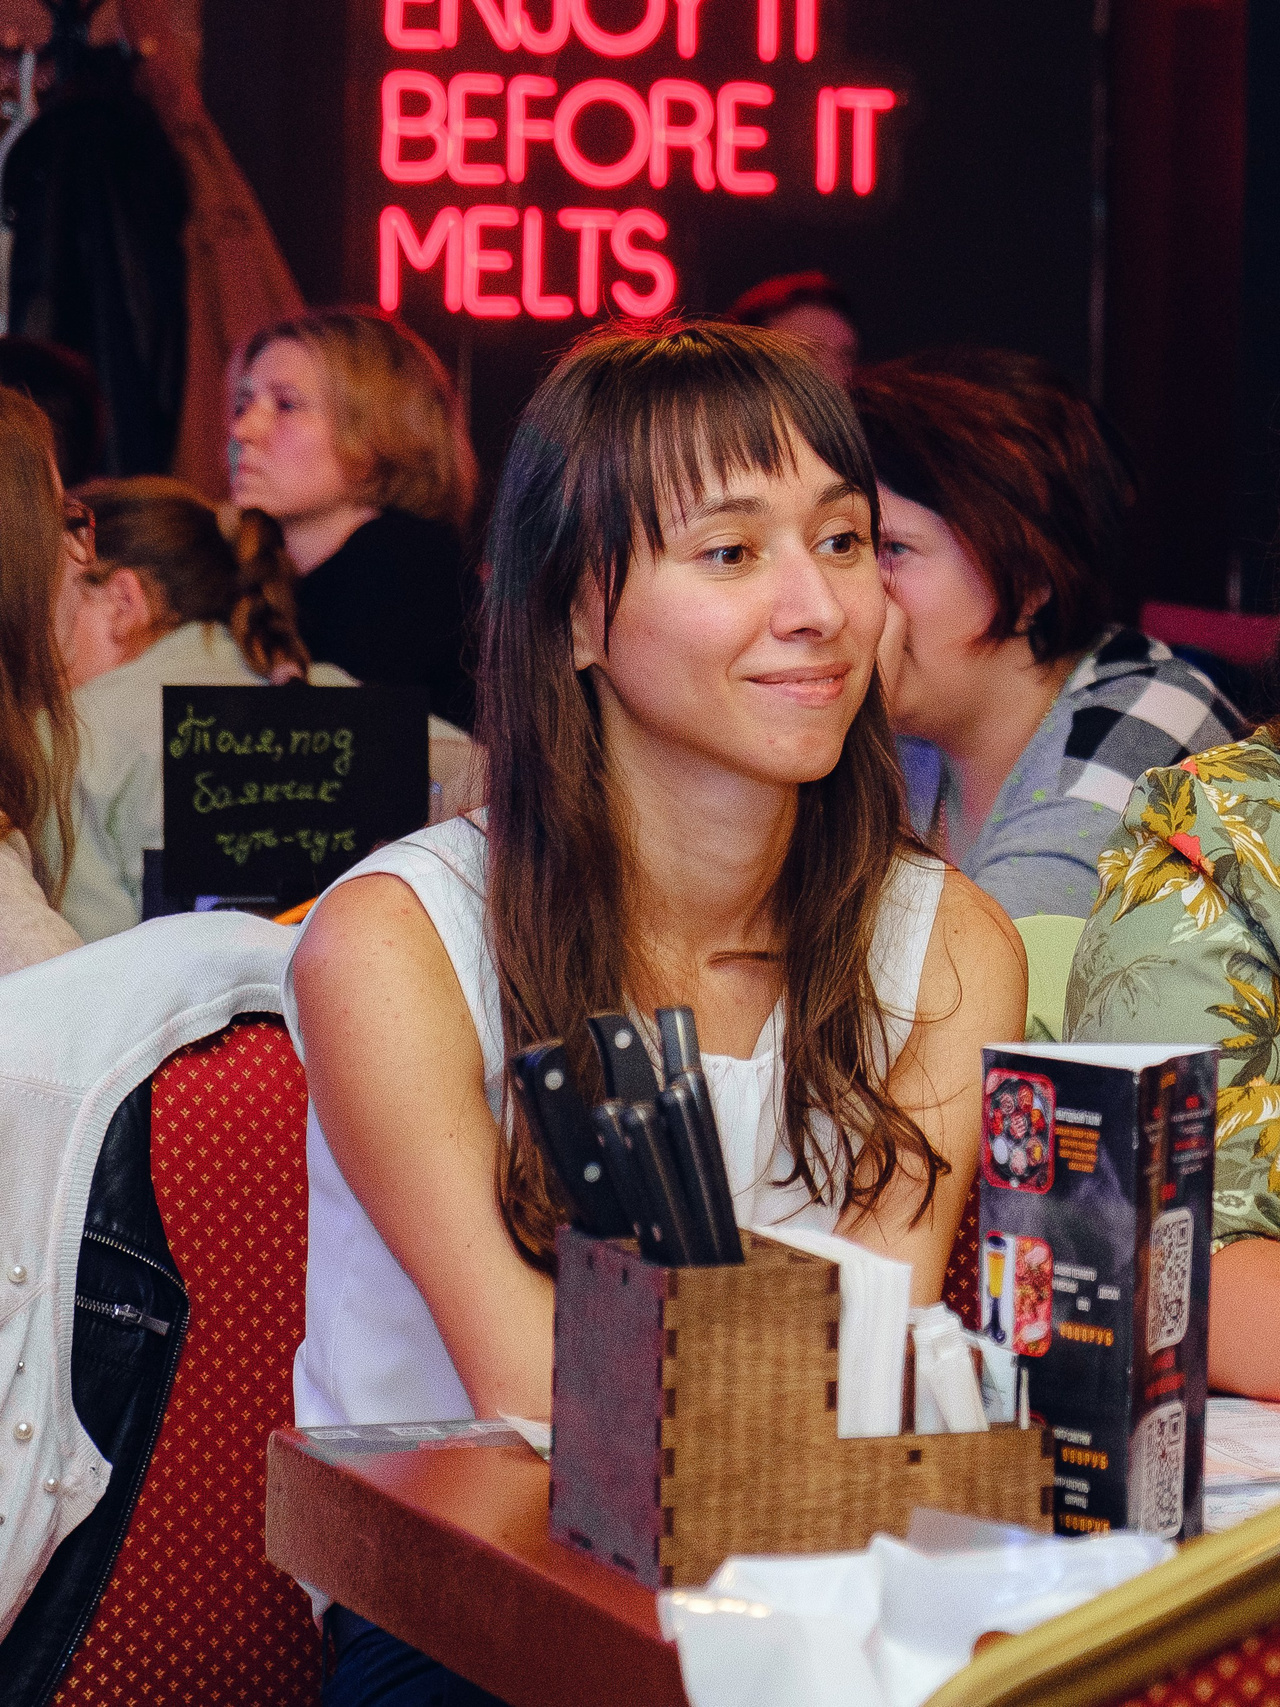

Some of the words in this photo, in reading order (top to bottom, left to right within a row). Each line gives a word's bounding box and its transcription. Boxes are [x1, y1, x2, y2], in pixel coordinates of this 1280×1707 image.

[380, 69, 777, 194] BEFORE
[815, 86, 897, 194] IT
[379, 204, 677, 319] MELTS
[289, 728, 355, 776] под
